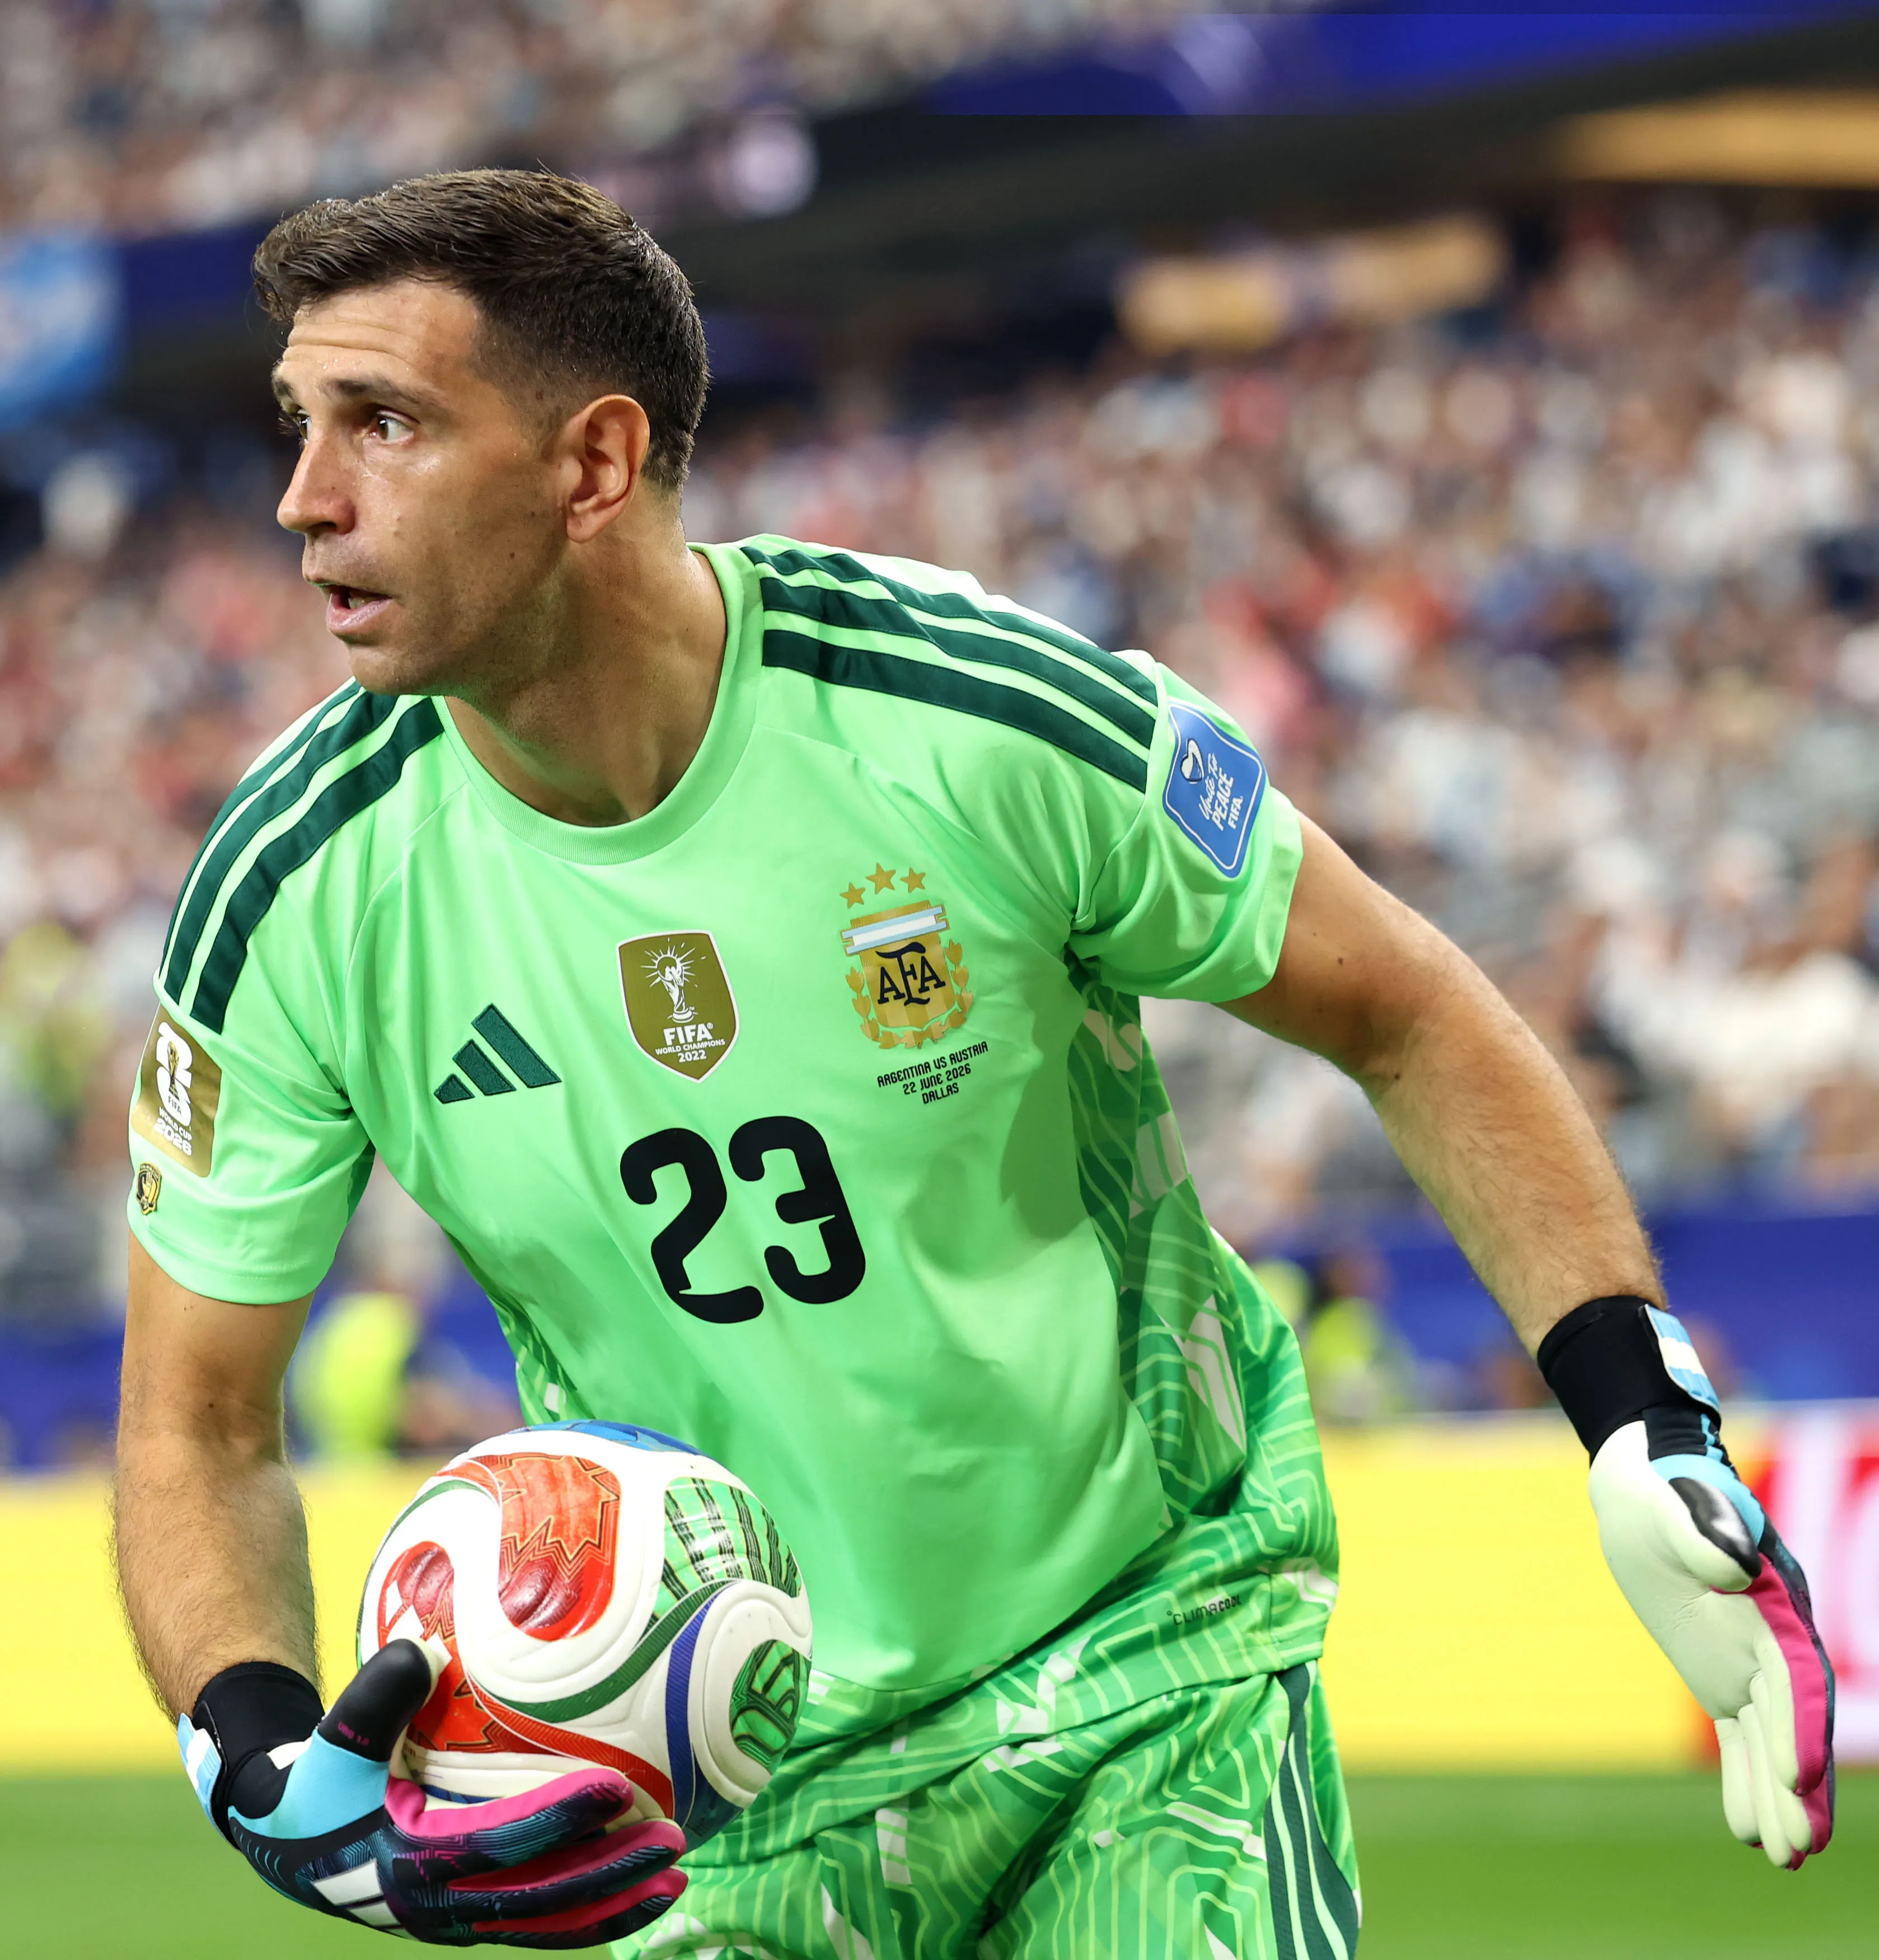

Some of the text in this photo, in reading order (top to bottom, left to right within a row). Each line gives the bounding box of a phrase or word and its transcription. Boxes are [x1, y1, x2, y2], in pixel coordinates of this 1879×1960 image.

[1212, 767, 1234, 831] PEACE
[1227, 796, 1243, 830] FIFA
[875, 941, 946, 1006] AFA
[655, 1039, 725, 1055] WORLD CHAMPIONS
[678, 1050, 707, 1063] 2022
[877, 1061, 931, 1088] ARGENTINA
[949, 1041, 988, 1064] AUSTRIA
[902, 1063, 971, 1096] 22 JUNE 2026
[168, 1095, 182, 1116] FIFA
[922, 1082, 959, 1105] DALLAS
[153, 1117, 192, 1156] 2026
[158, 1106, 193, 1141] WORLD CUP
[620, 1115, 866, 1323] 23
